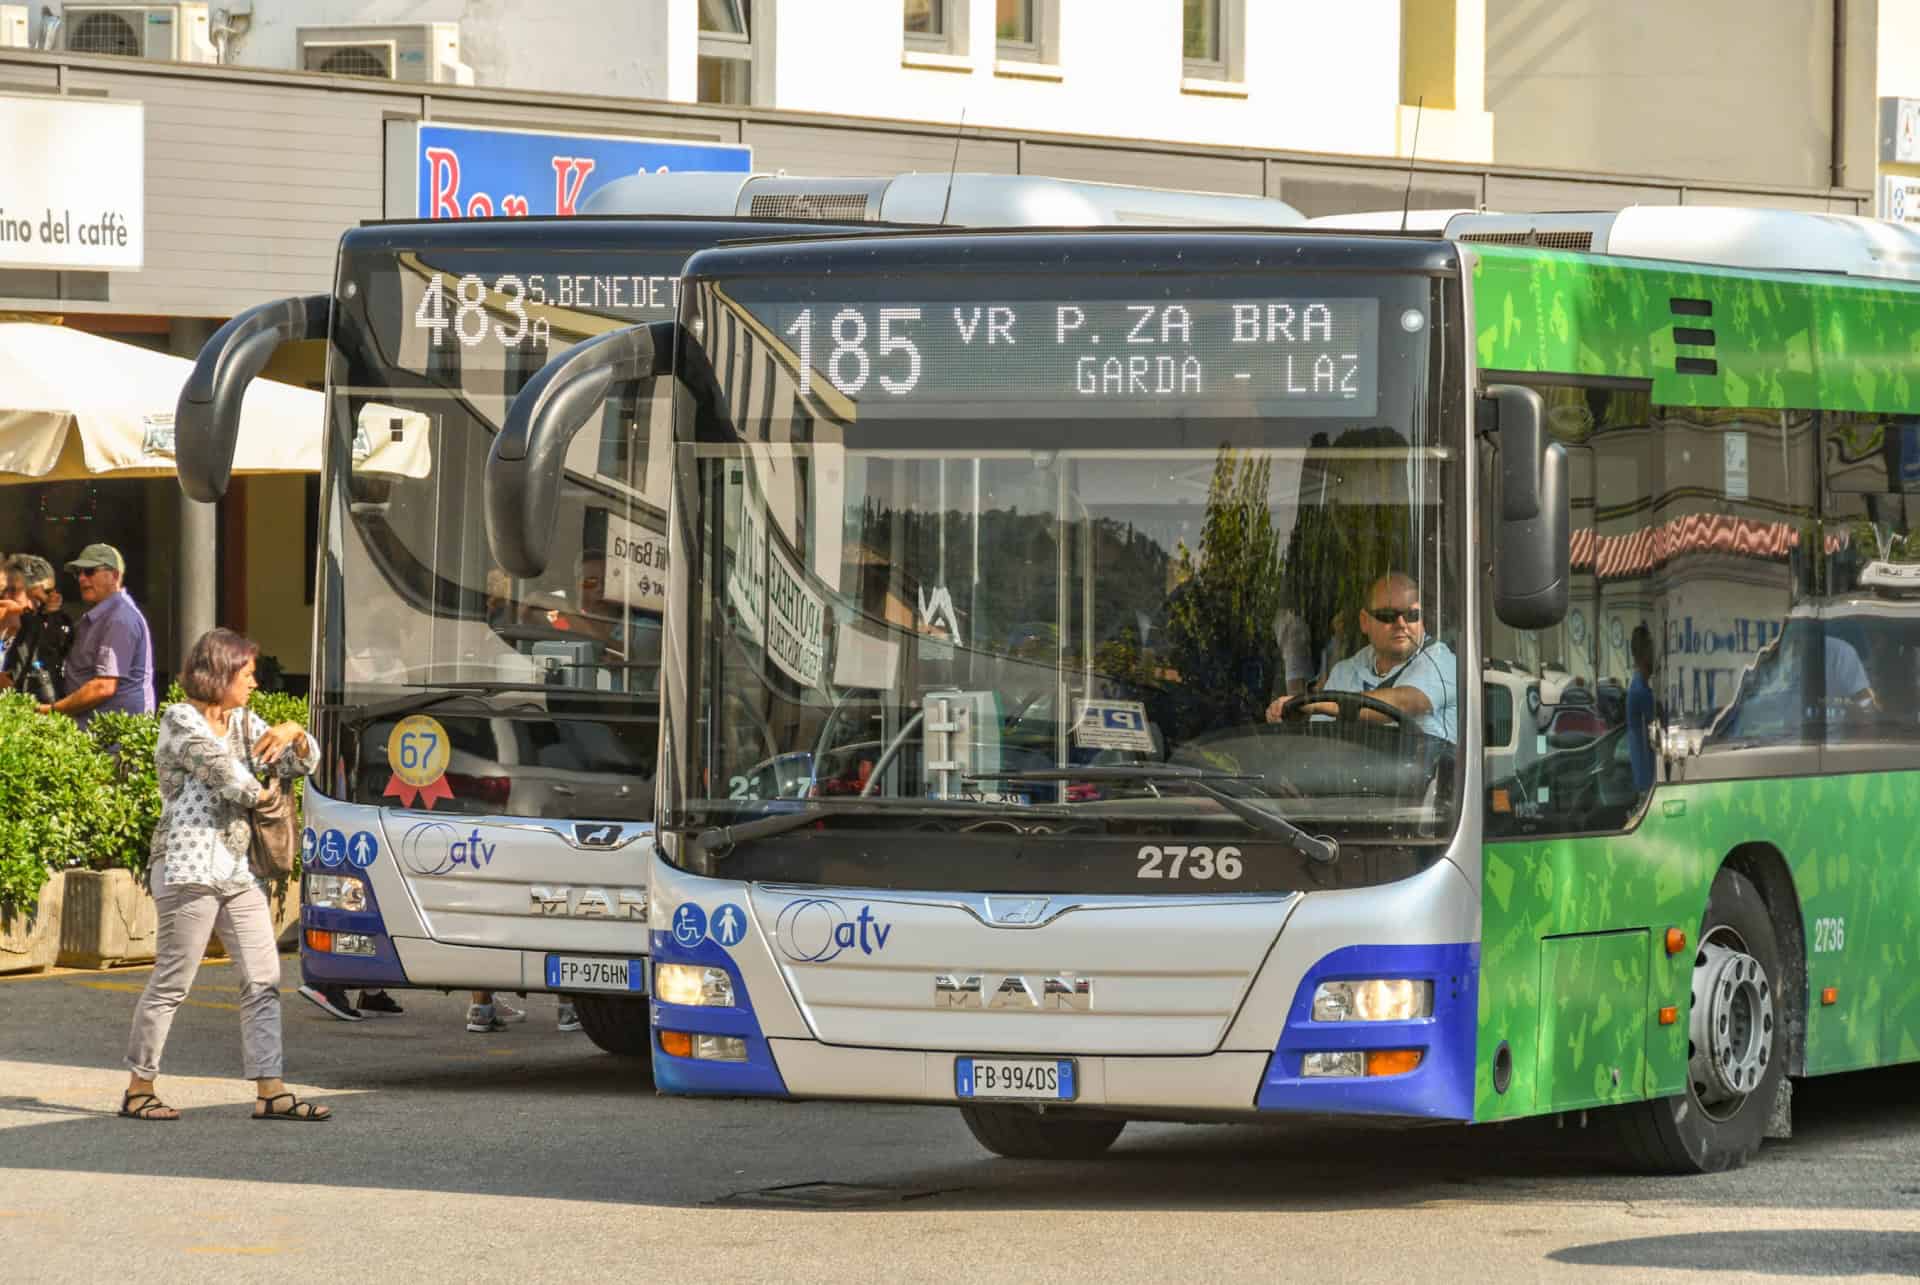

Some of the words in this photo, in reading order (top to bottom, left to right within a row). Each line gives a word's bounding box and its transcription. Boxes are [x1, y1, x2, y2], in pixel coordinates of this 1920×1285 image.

[39, 207, 71, 244] del
[78, 211, 128, 247] caffè
[416, 274, 528, 347] 483
[786, 308, 921, 394] 185
[954, 307, 1016, 344] VR
[1127, 305, 1190, 342] ZA
[1232, 304, 1331, 341] BRA
[1077, 356, 1201, 393] GARDA
[401, 732, 437, 769] 67
[450, 828, 497, 870] atv
[1137, 846, 1242, 880] 2736
[835, 905, 892, 955] atv
[1814, 917, 1845, 952] 2736
[935, 975, 1095, 1010] MAN
